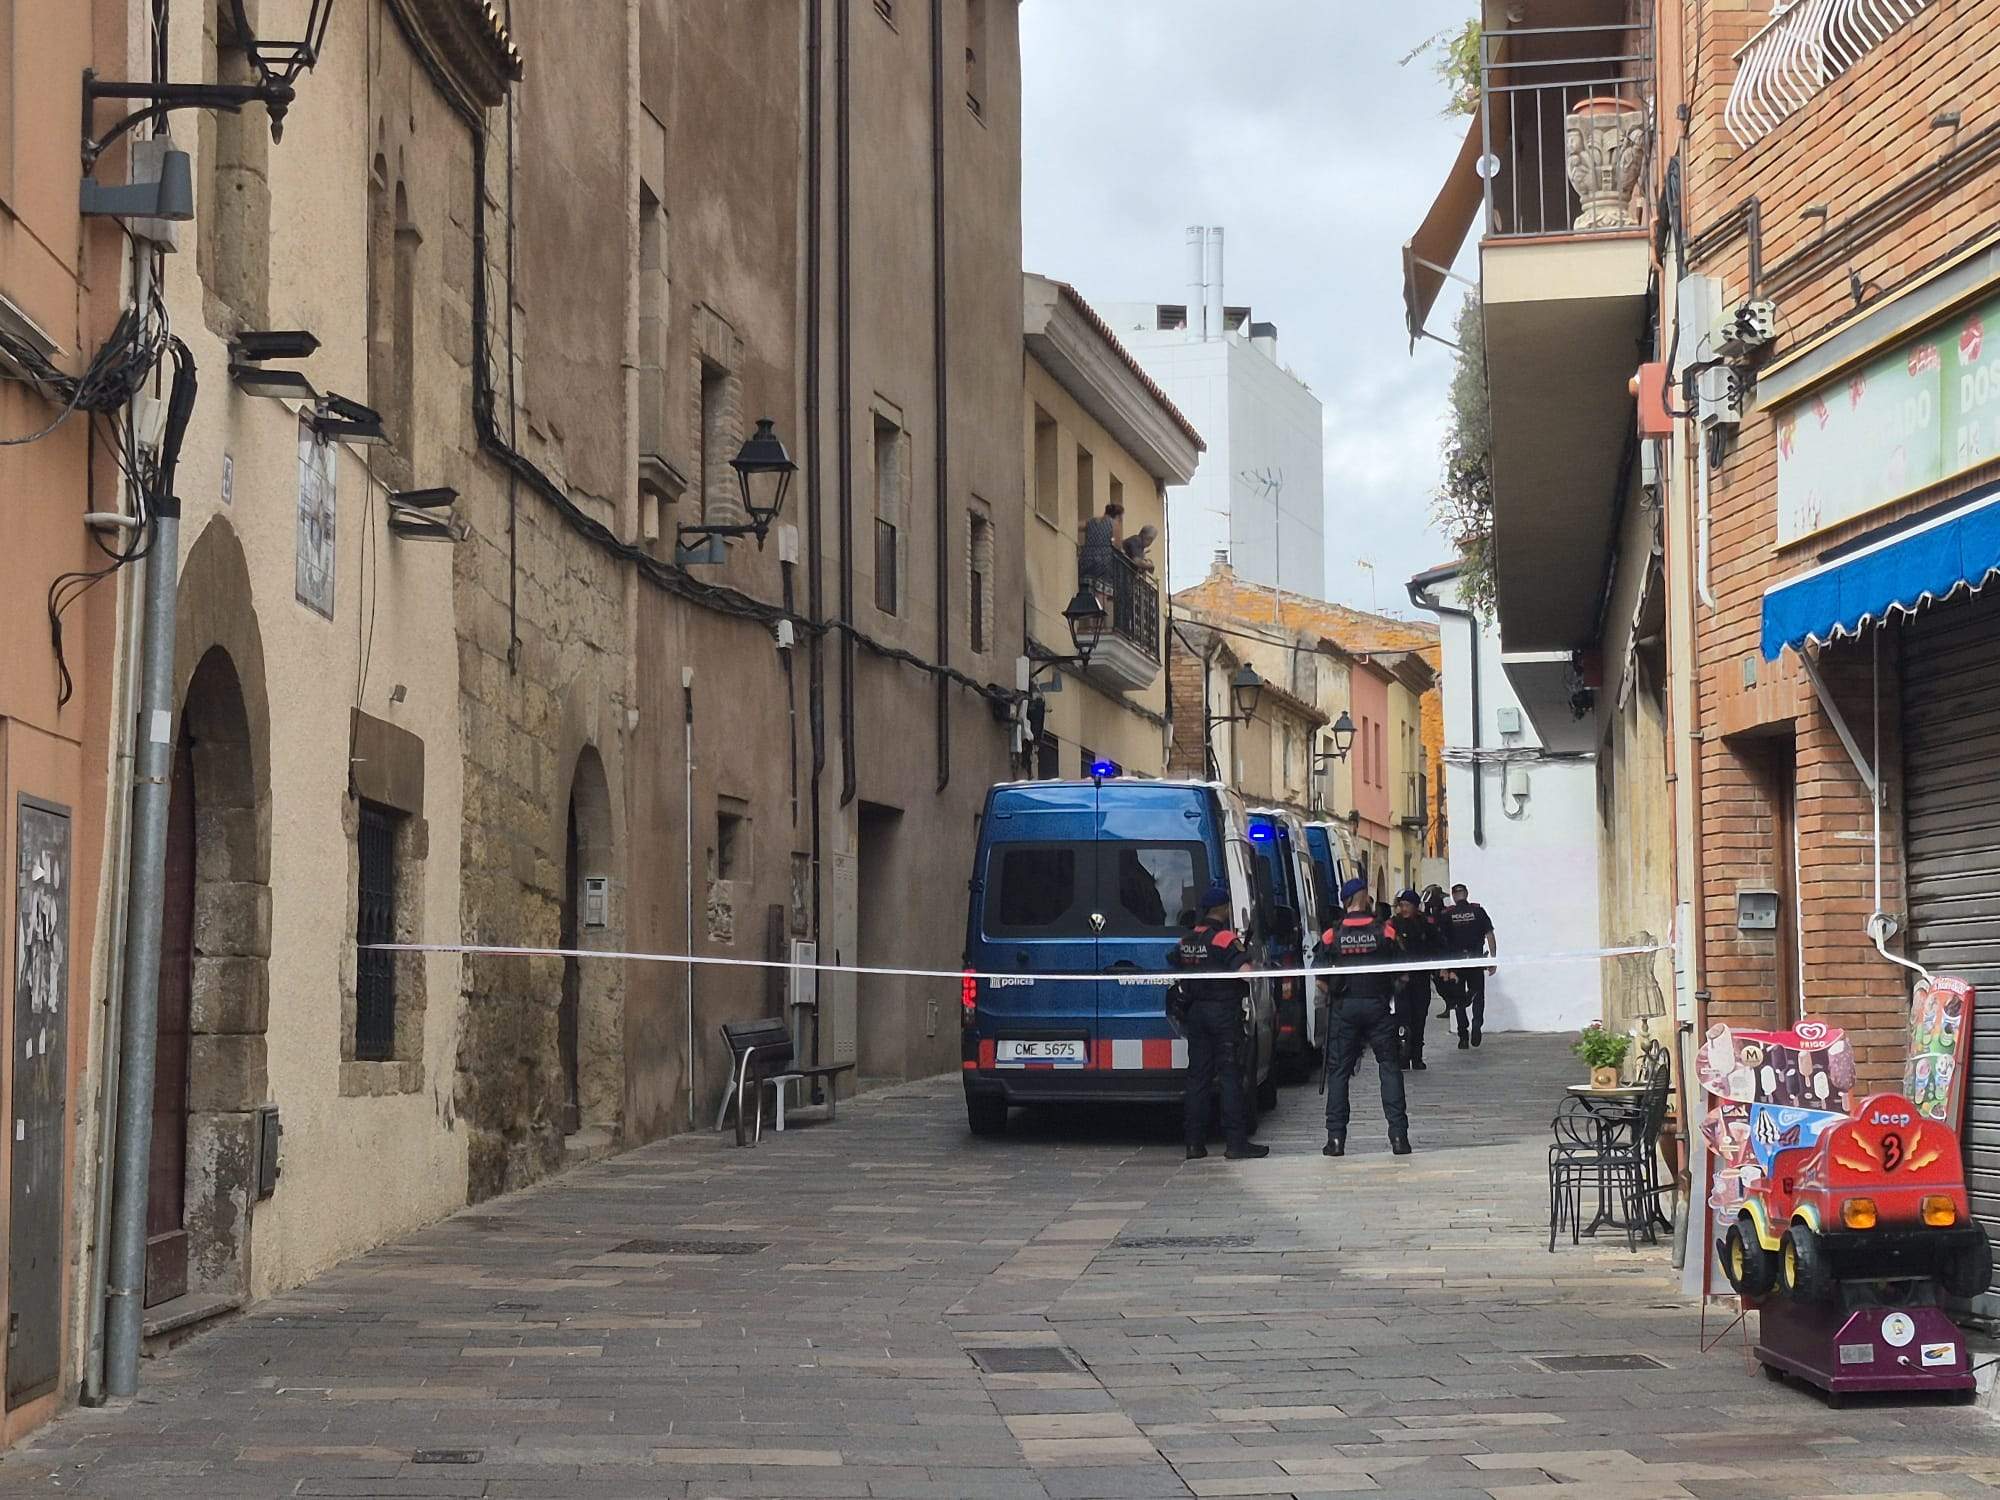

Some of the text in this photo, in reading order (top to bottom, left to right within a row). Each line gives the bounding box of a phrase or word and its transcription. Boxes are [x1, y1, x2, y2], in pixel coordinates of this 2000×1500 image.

[1340, 934, 1376, 943] POLICIA
[1015, 1043, 1075, 1055] CME 5675
[1800, 1041, 1826, 1049] FRIGO
[1870, 1111, 1910, 1127] Jeep
[1882, 1133, 1903, 1171] 3
